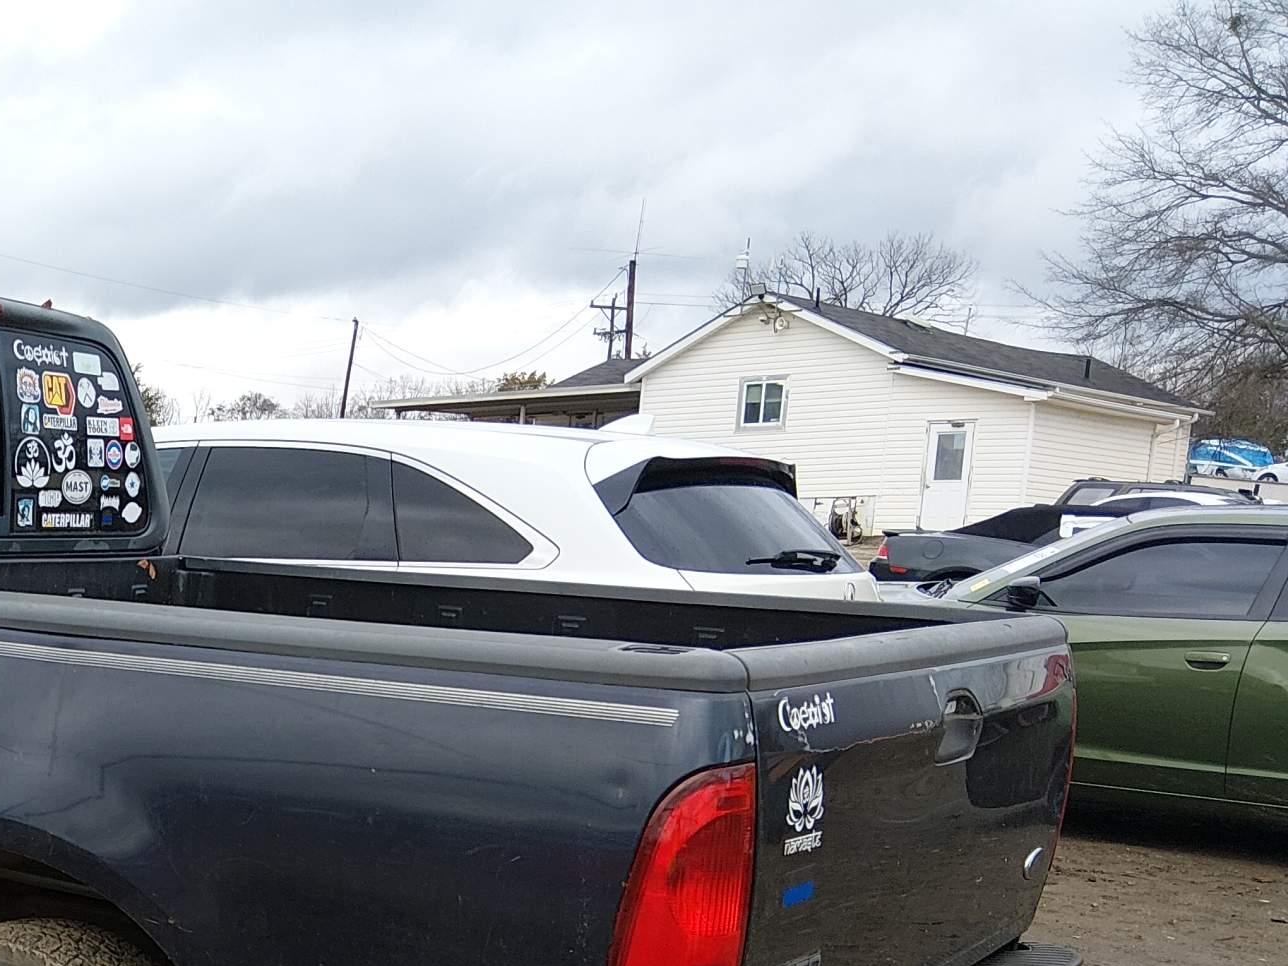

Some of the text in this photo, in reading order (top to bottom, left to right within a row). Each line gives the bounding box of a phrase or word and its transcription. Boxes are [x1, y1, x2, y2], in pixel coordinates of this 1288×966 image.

[44, 374, 67, 406] CAT
[87, 419, 108, 428] KLEIN
[88, 426, 108, 435] TOOLS
[65, 481, 89, 492] MAST
[42, 513, 91, 528] CATERPILLAR
